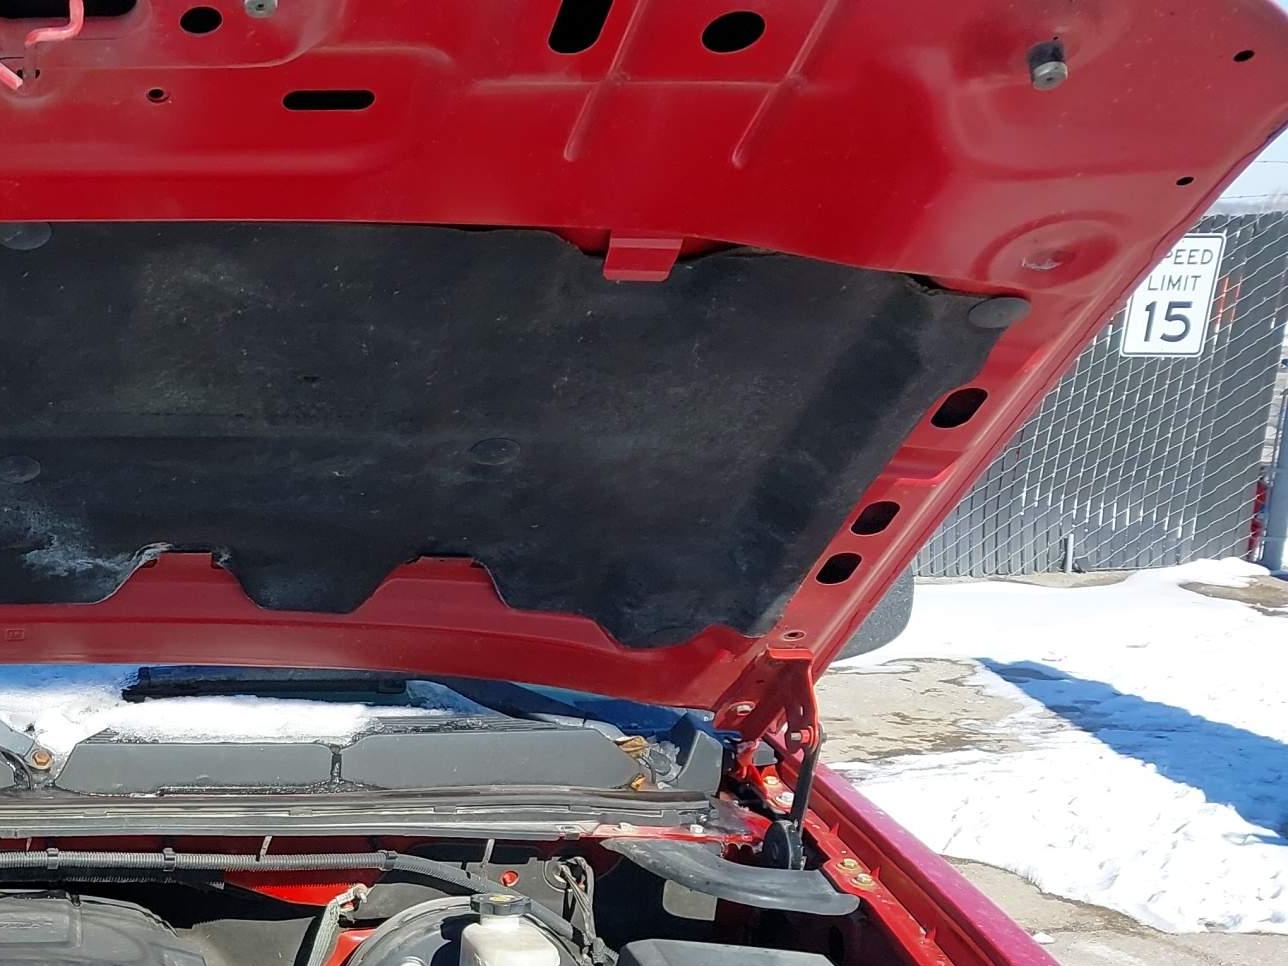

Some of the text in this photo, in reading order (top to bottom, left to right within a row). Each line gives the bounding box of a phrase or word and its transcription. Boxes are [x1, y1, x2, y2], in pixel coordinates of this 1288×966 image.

[1164, 249, 1213, 265] EED
[1147, 275, 1202, 291] LIMIT
[1144, 301, 1193, 342] 15
